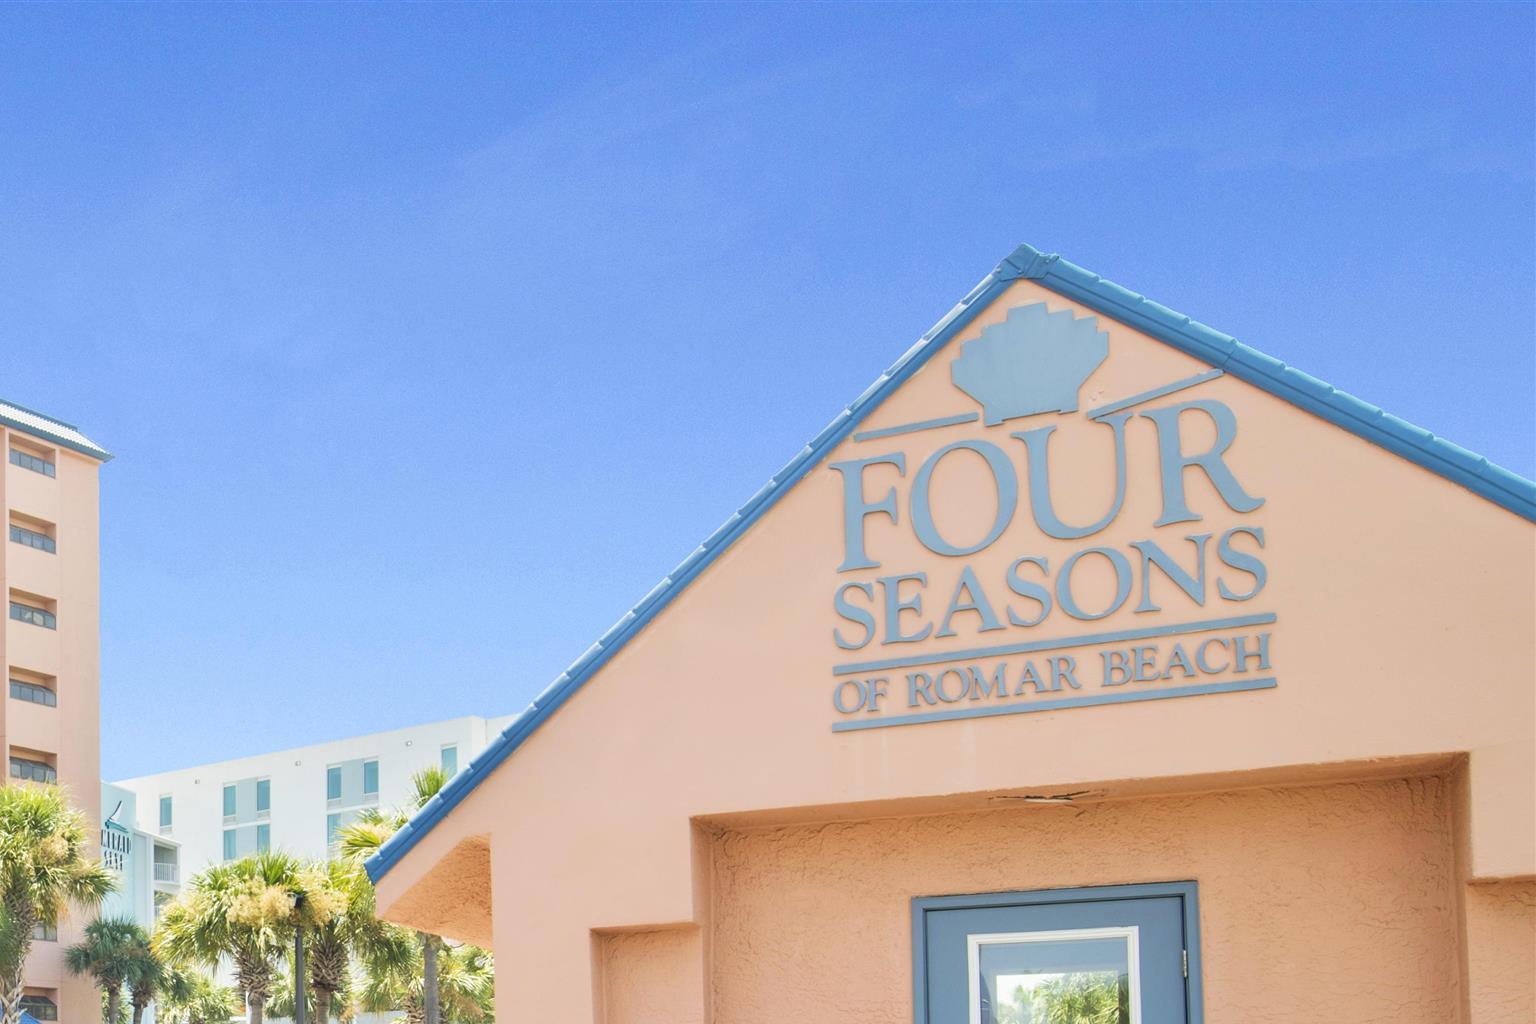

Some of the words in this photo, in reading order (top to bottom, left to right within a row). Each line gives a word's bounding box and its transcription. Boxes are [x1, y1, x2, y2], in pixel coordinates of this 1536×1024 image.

[828, 399, 1266, 573] FOUR
[833, 526, 1268, 650] SEASONS
[833, 677, 889, 714] OF
[906, 656, 1082, 707] ROMAR
[1100, 632, 1272, 687] BEACH
